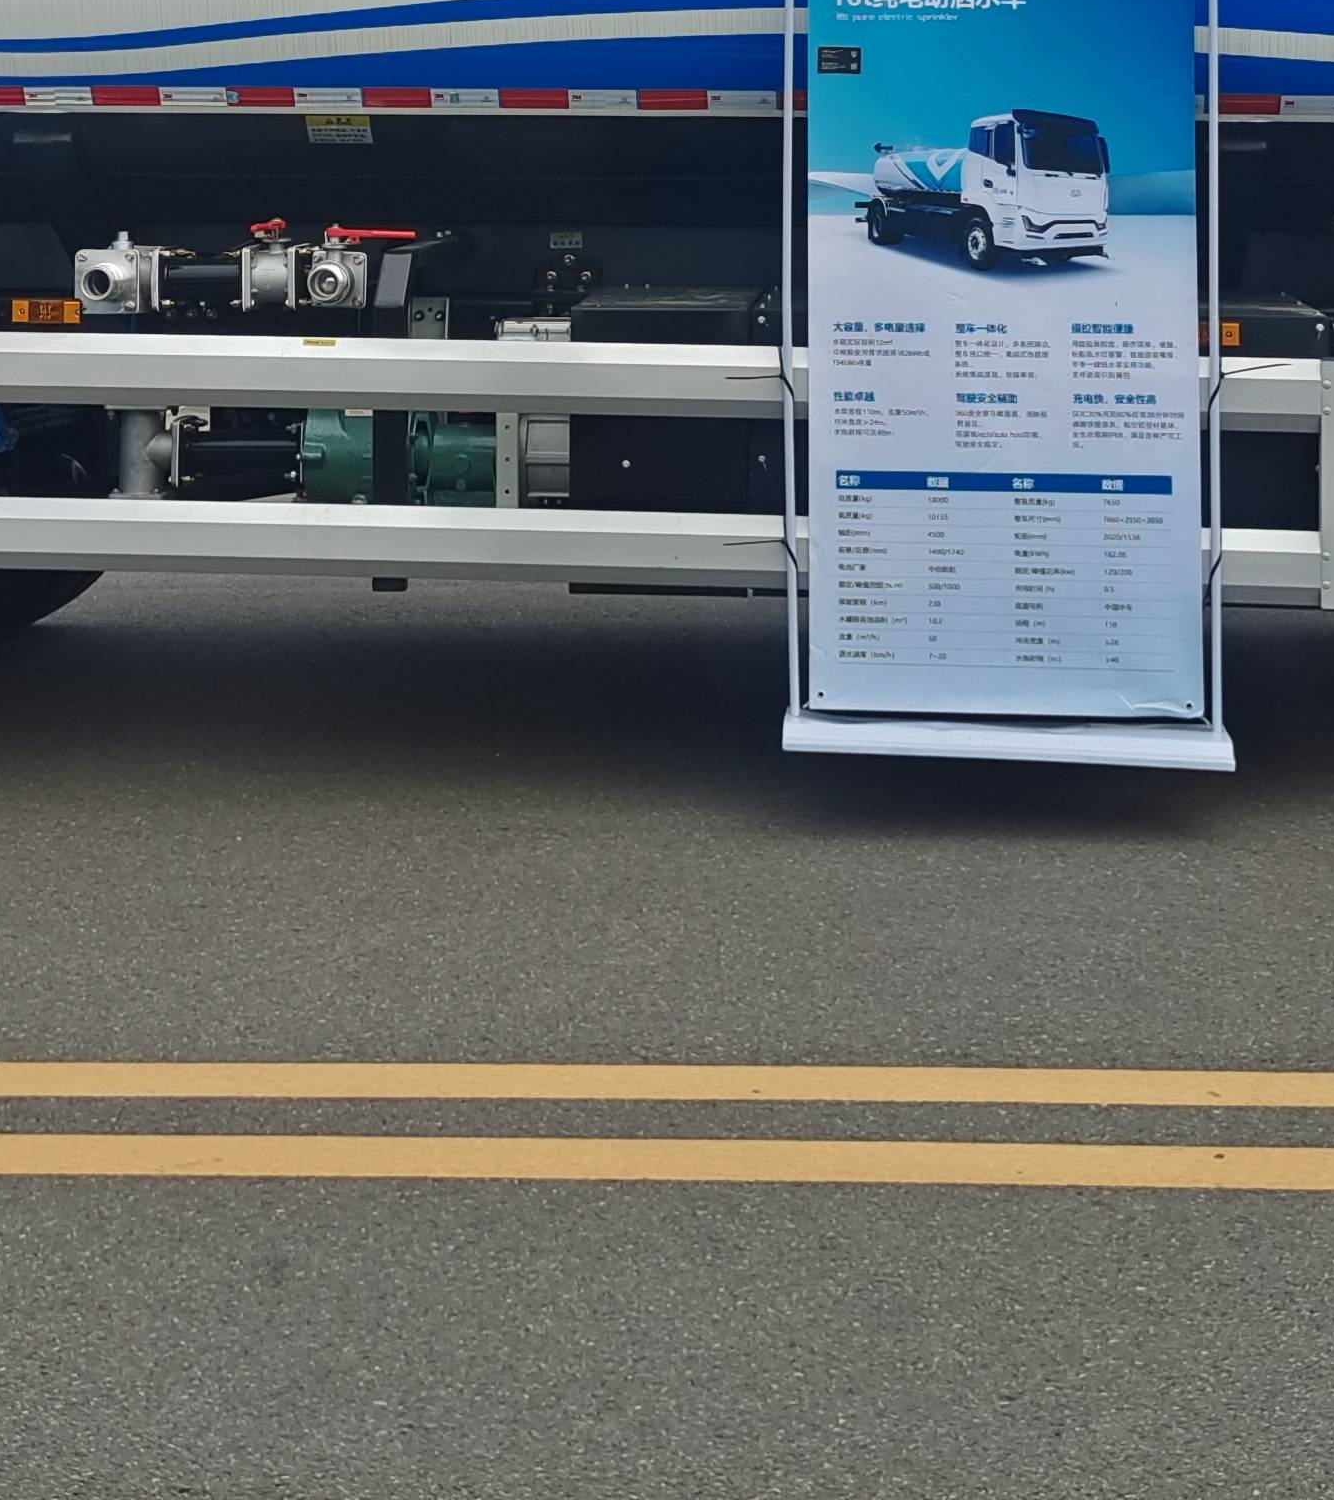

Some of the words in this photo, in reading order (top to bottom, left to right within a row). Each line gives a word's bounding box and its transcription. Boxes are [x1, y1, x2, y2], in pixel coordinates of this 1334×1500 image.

[852, 14, 875, 22] pure
[878, 13, 914, 21] electric
[916, 13, 959, 22] sprinkler
[838, 475, 861, 486] 名称
[1012, 477, 1035, 489] 名称
